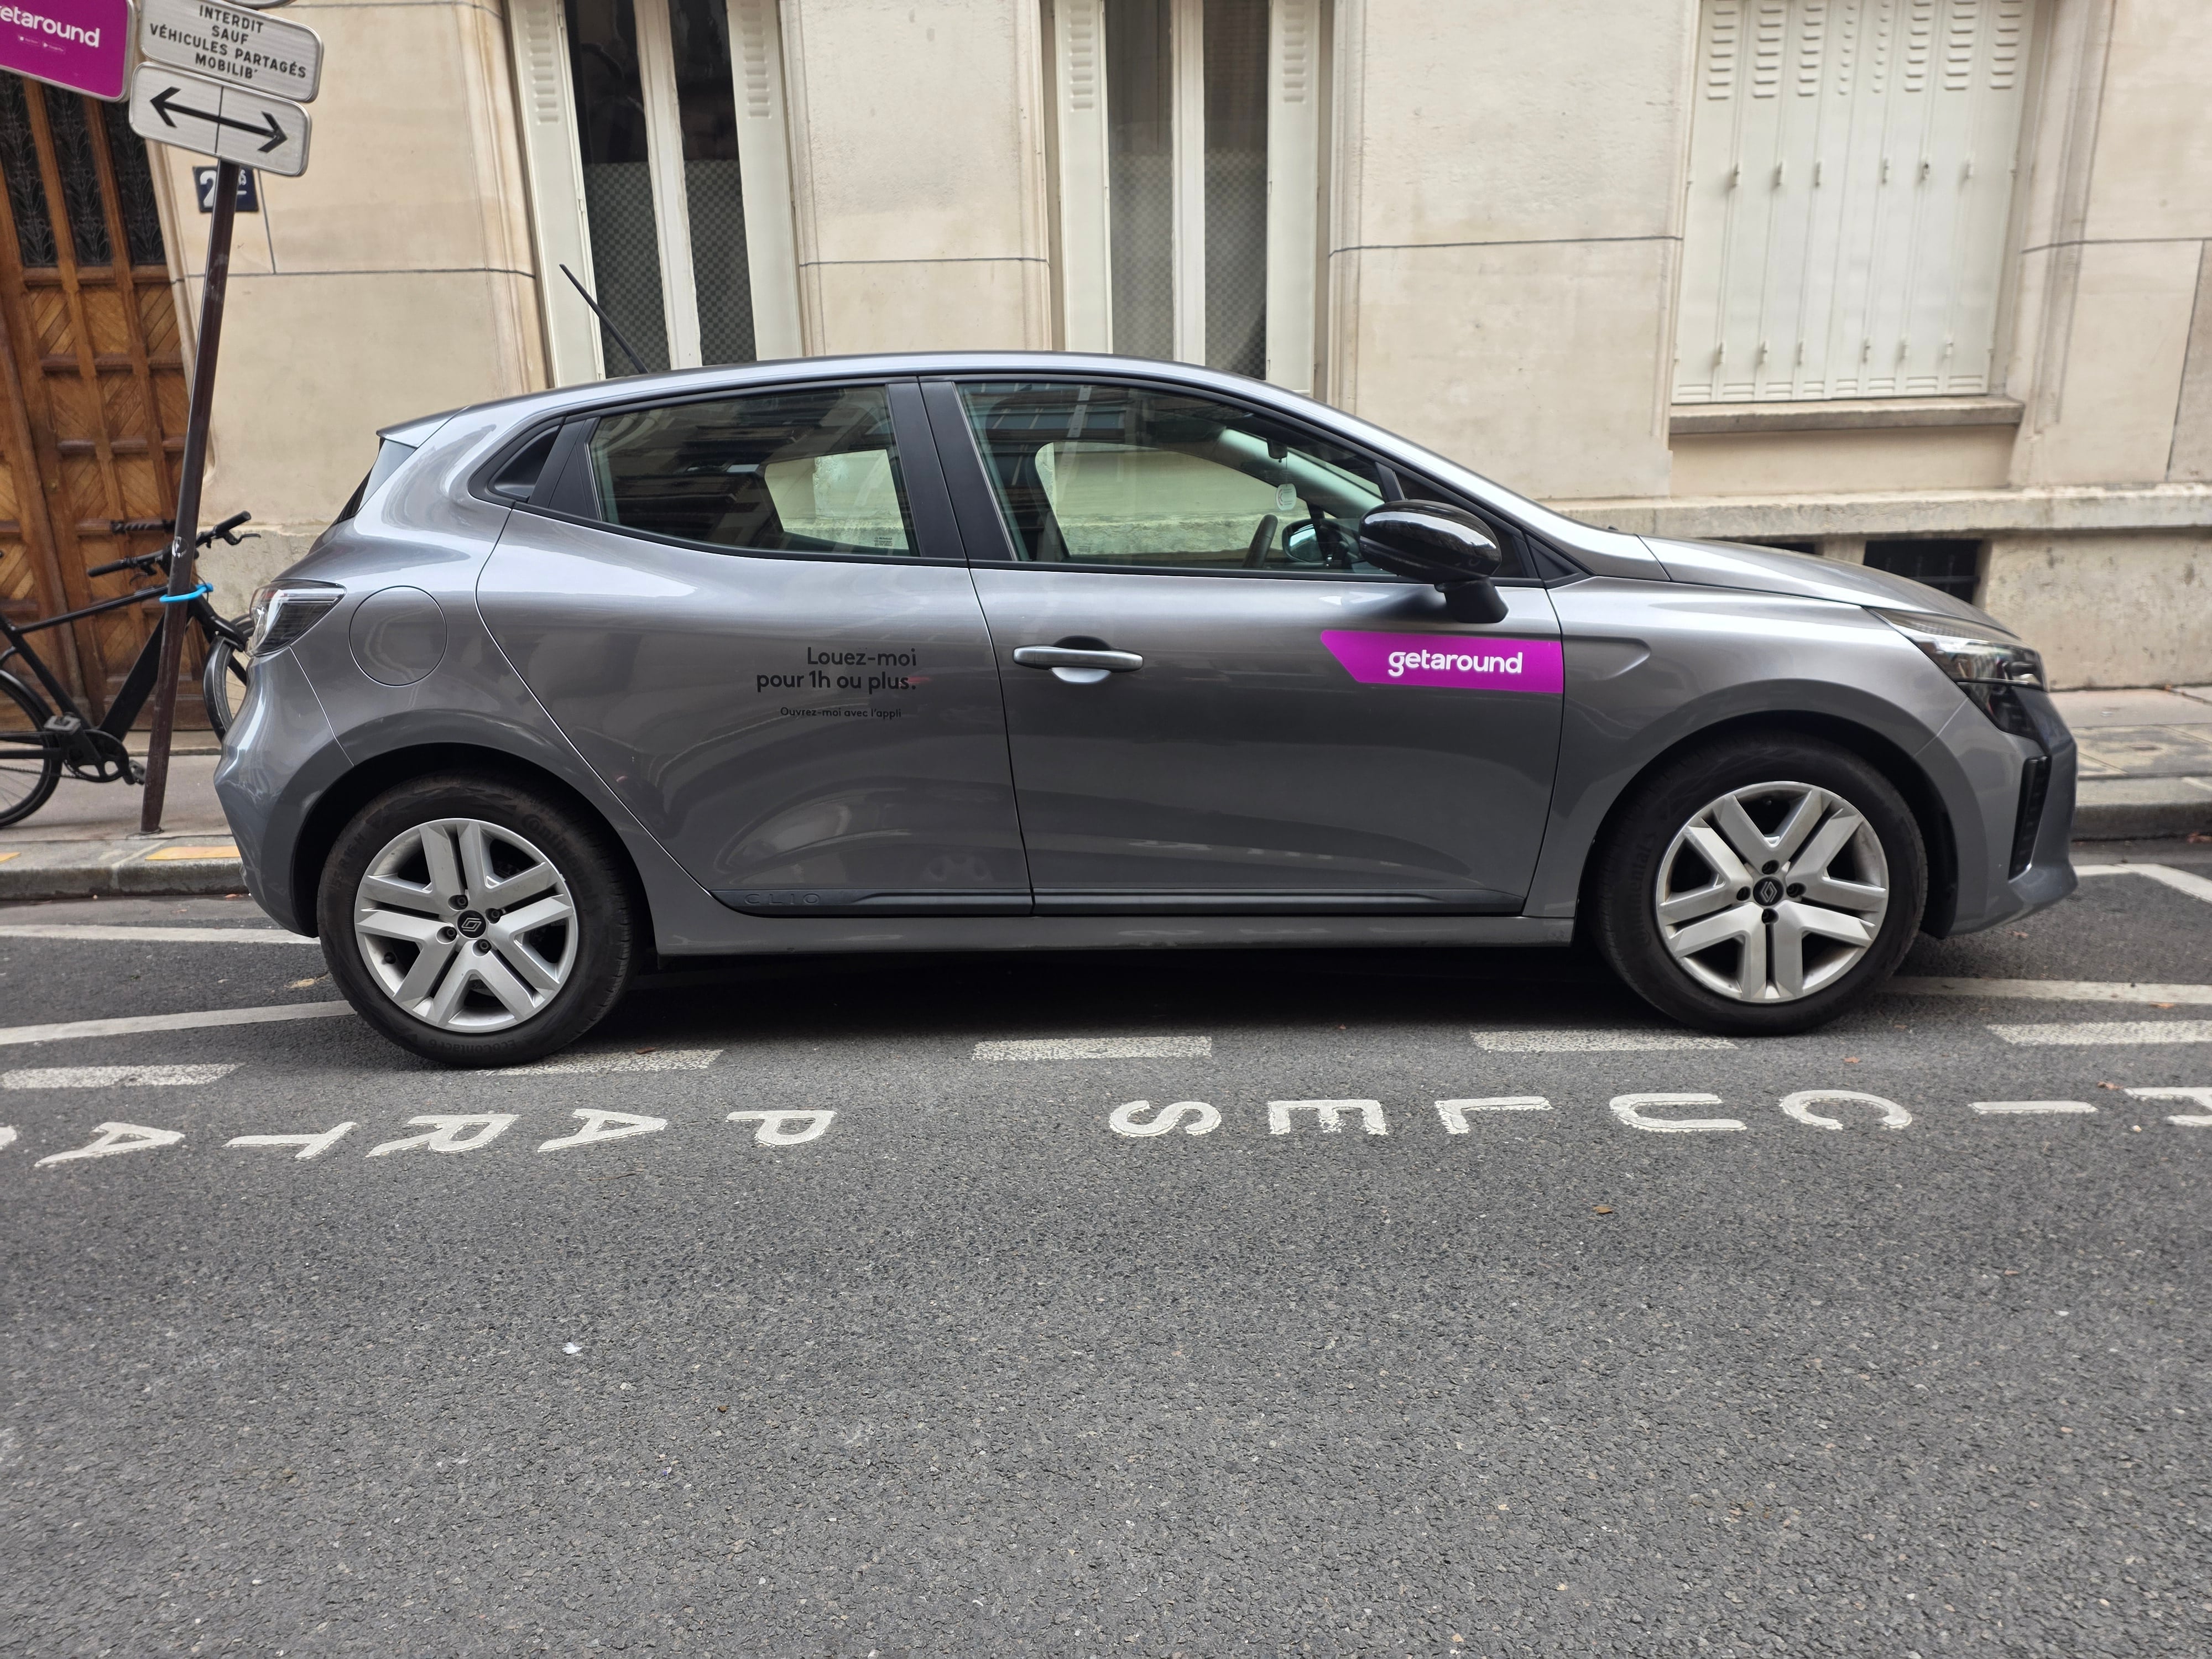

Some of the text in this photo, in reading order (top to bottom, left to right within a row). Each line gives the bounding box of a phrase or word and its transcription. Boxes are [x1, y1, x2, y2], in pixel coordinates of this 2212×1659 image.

[0, 6, 100, 48] etaround
[200, 5, 264, 33] INTERDIT
[212, 25, 249, 45] SAUF
[150, 23, 306, 78] VÉHICULES PARTAGÉS
[807, 647, 917, 666] Louez-moi
[1388, 649, 1523, 677] getaround
[757, 670, 916, 695] pour 1h ou plus.
[780, 707, 901, 720] Ouvrez-moi avec l'appli
[744, 893, 821, 906] CLIO
